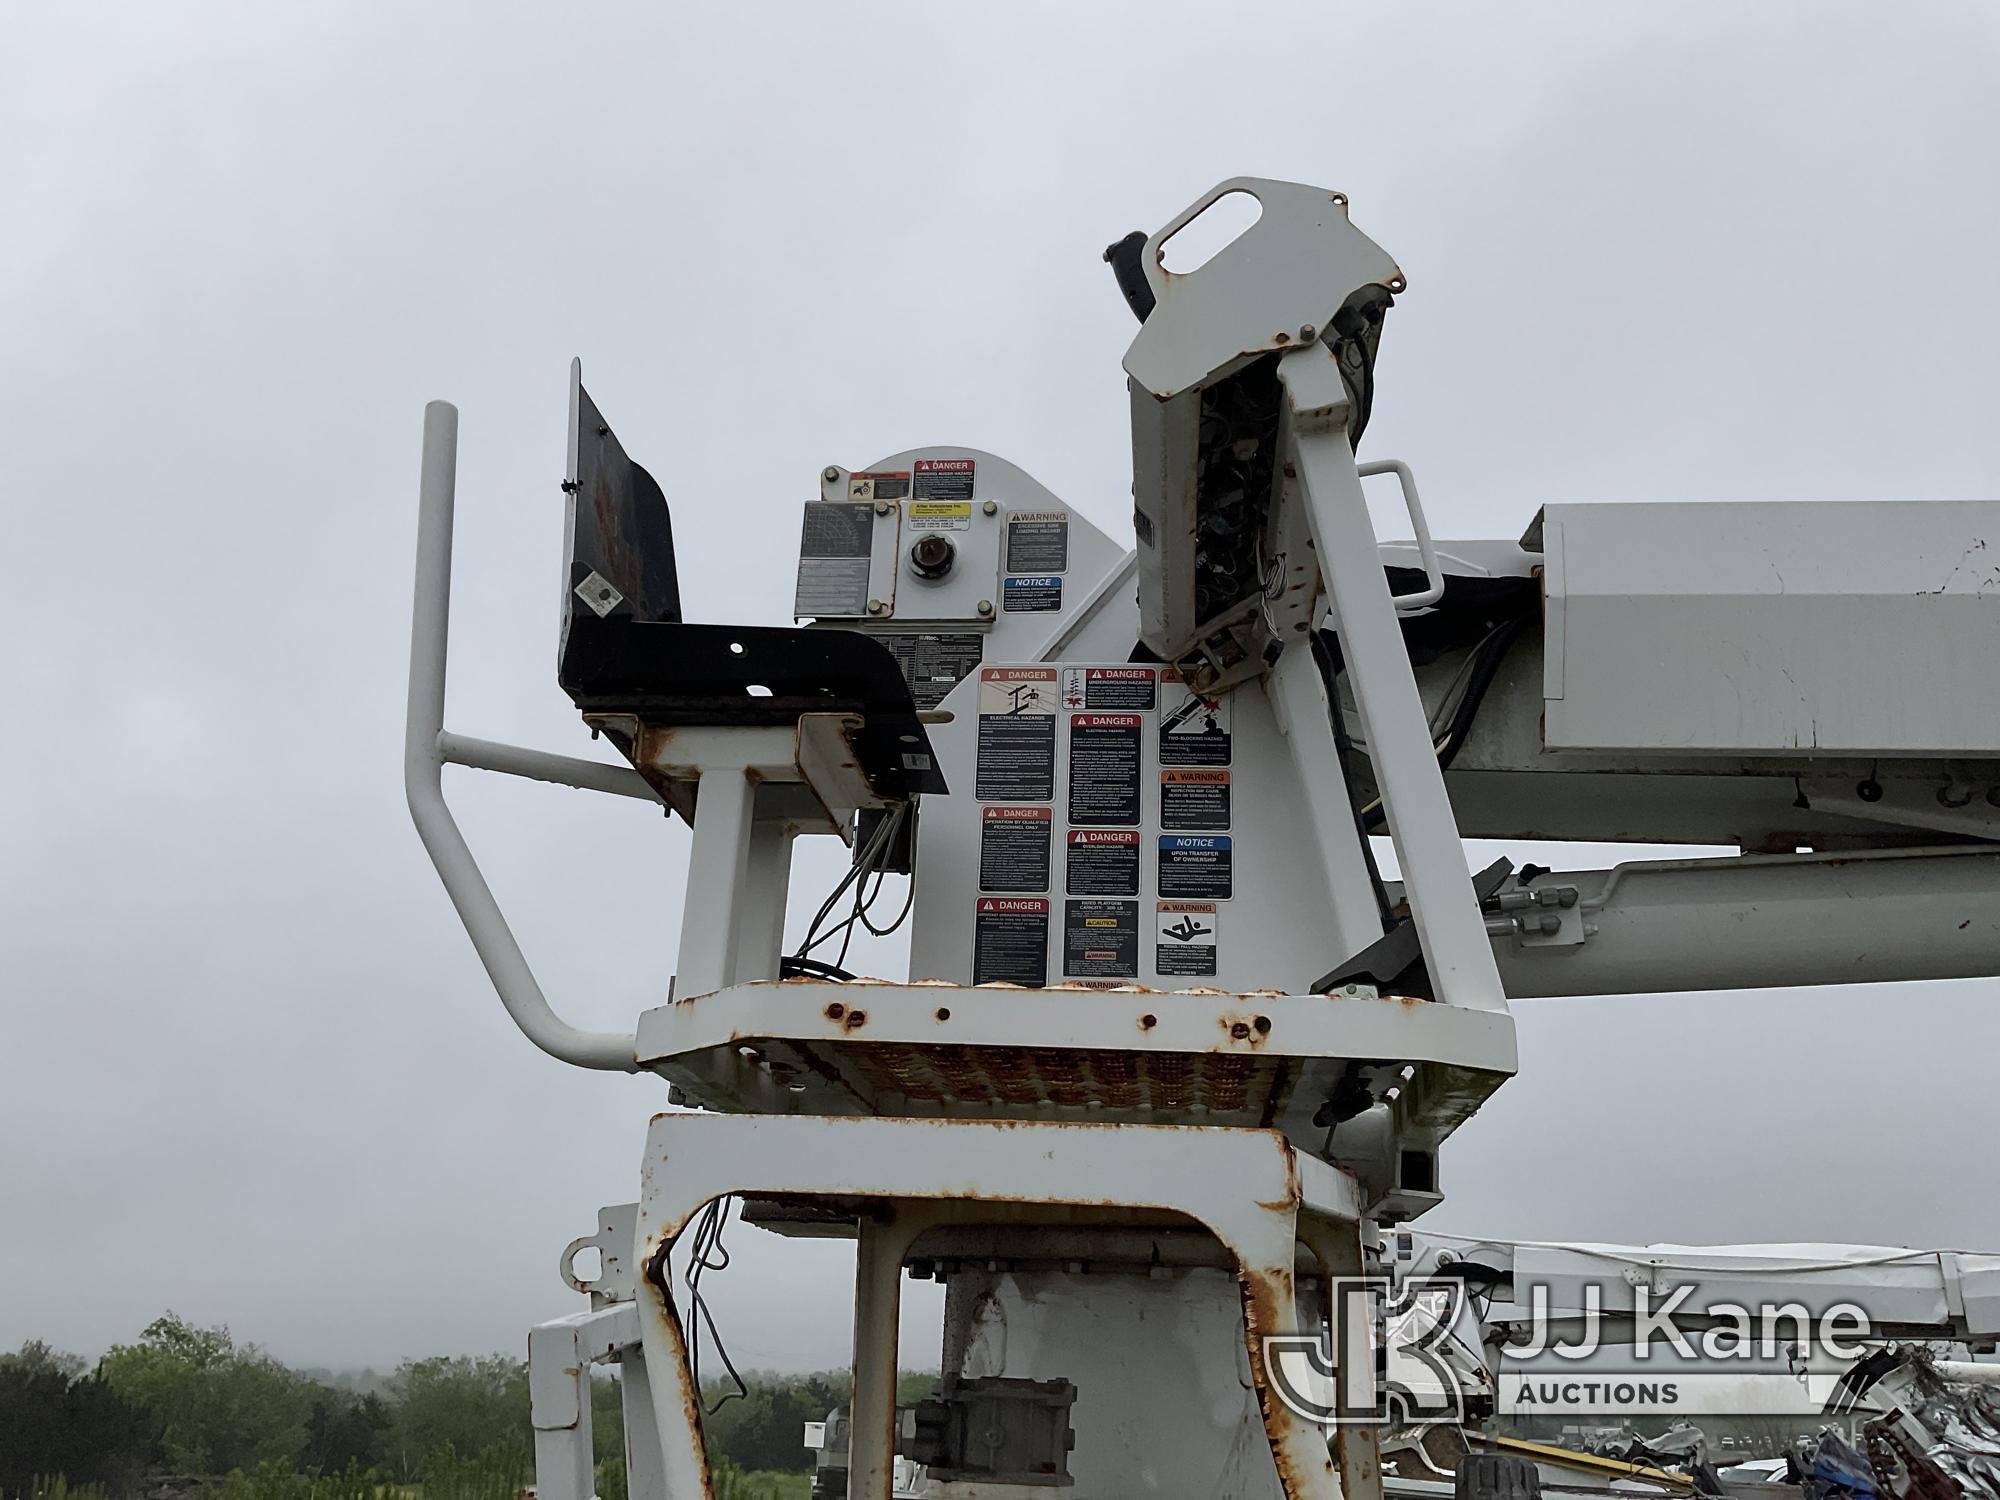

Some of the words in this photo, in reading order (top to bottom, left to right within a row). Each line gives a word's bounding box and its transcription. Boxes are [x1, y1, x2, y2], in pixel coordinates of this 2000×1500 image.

[933, 462, 968, 470] DANGER
[1021, 513, 1066, 521] WARNING
[1015, 578, 1052, 586] NOTICE
[1008, 671, 1047, 679] DANGER
[1106, 670, 1146, 678] DANGER
[1092, 717, 1134, 725] DANGER
[1180, 773, 1224, 781] WARNING
[1004, 809, 1039, 817] DANGER
[1090, 833, 1132, 842] DANGER
[1176, 838, 1215, 847] NOTICE
[1000, 901, 1041, 910] DANGER
[1172, 904, 1212, 912] WARNING
